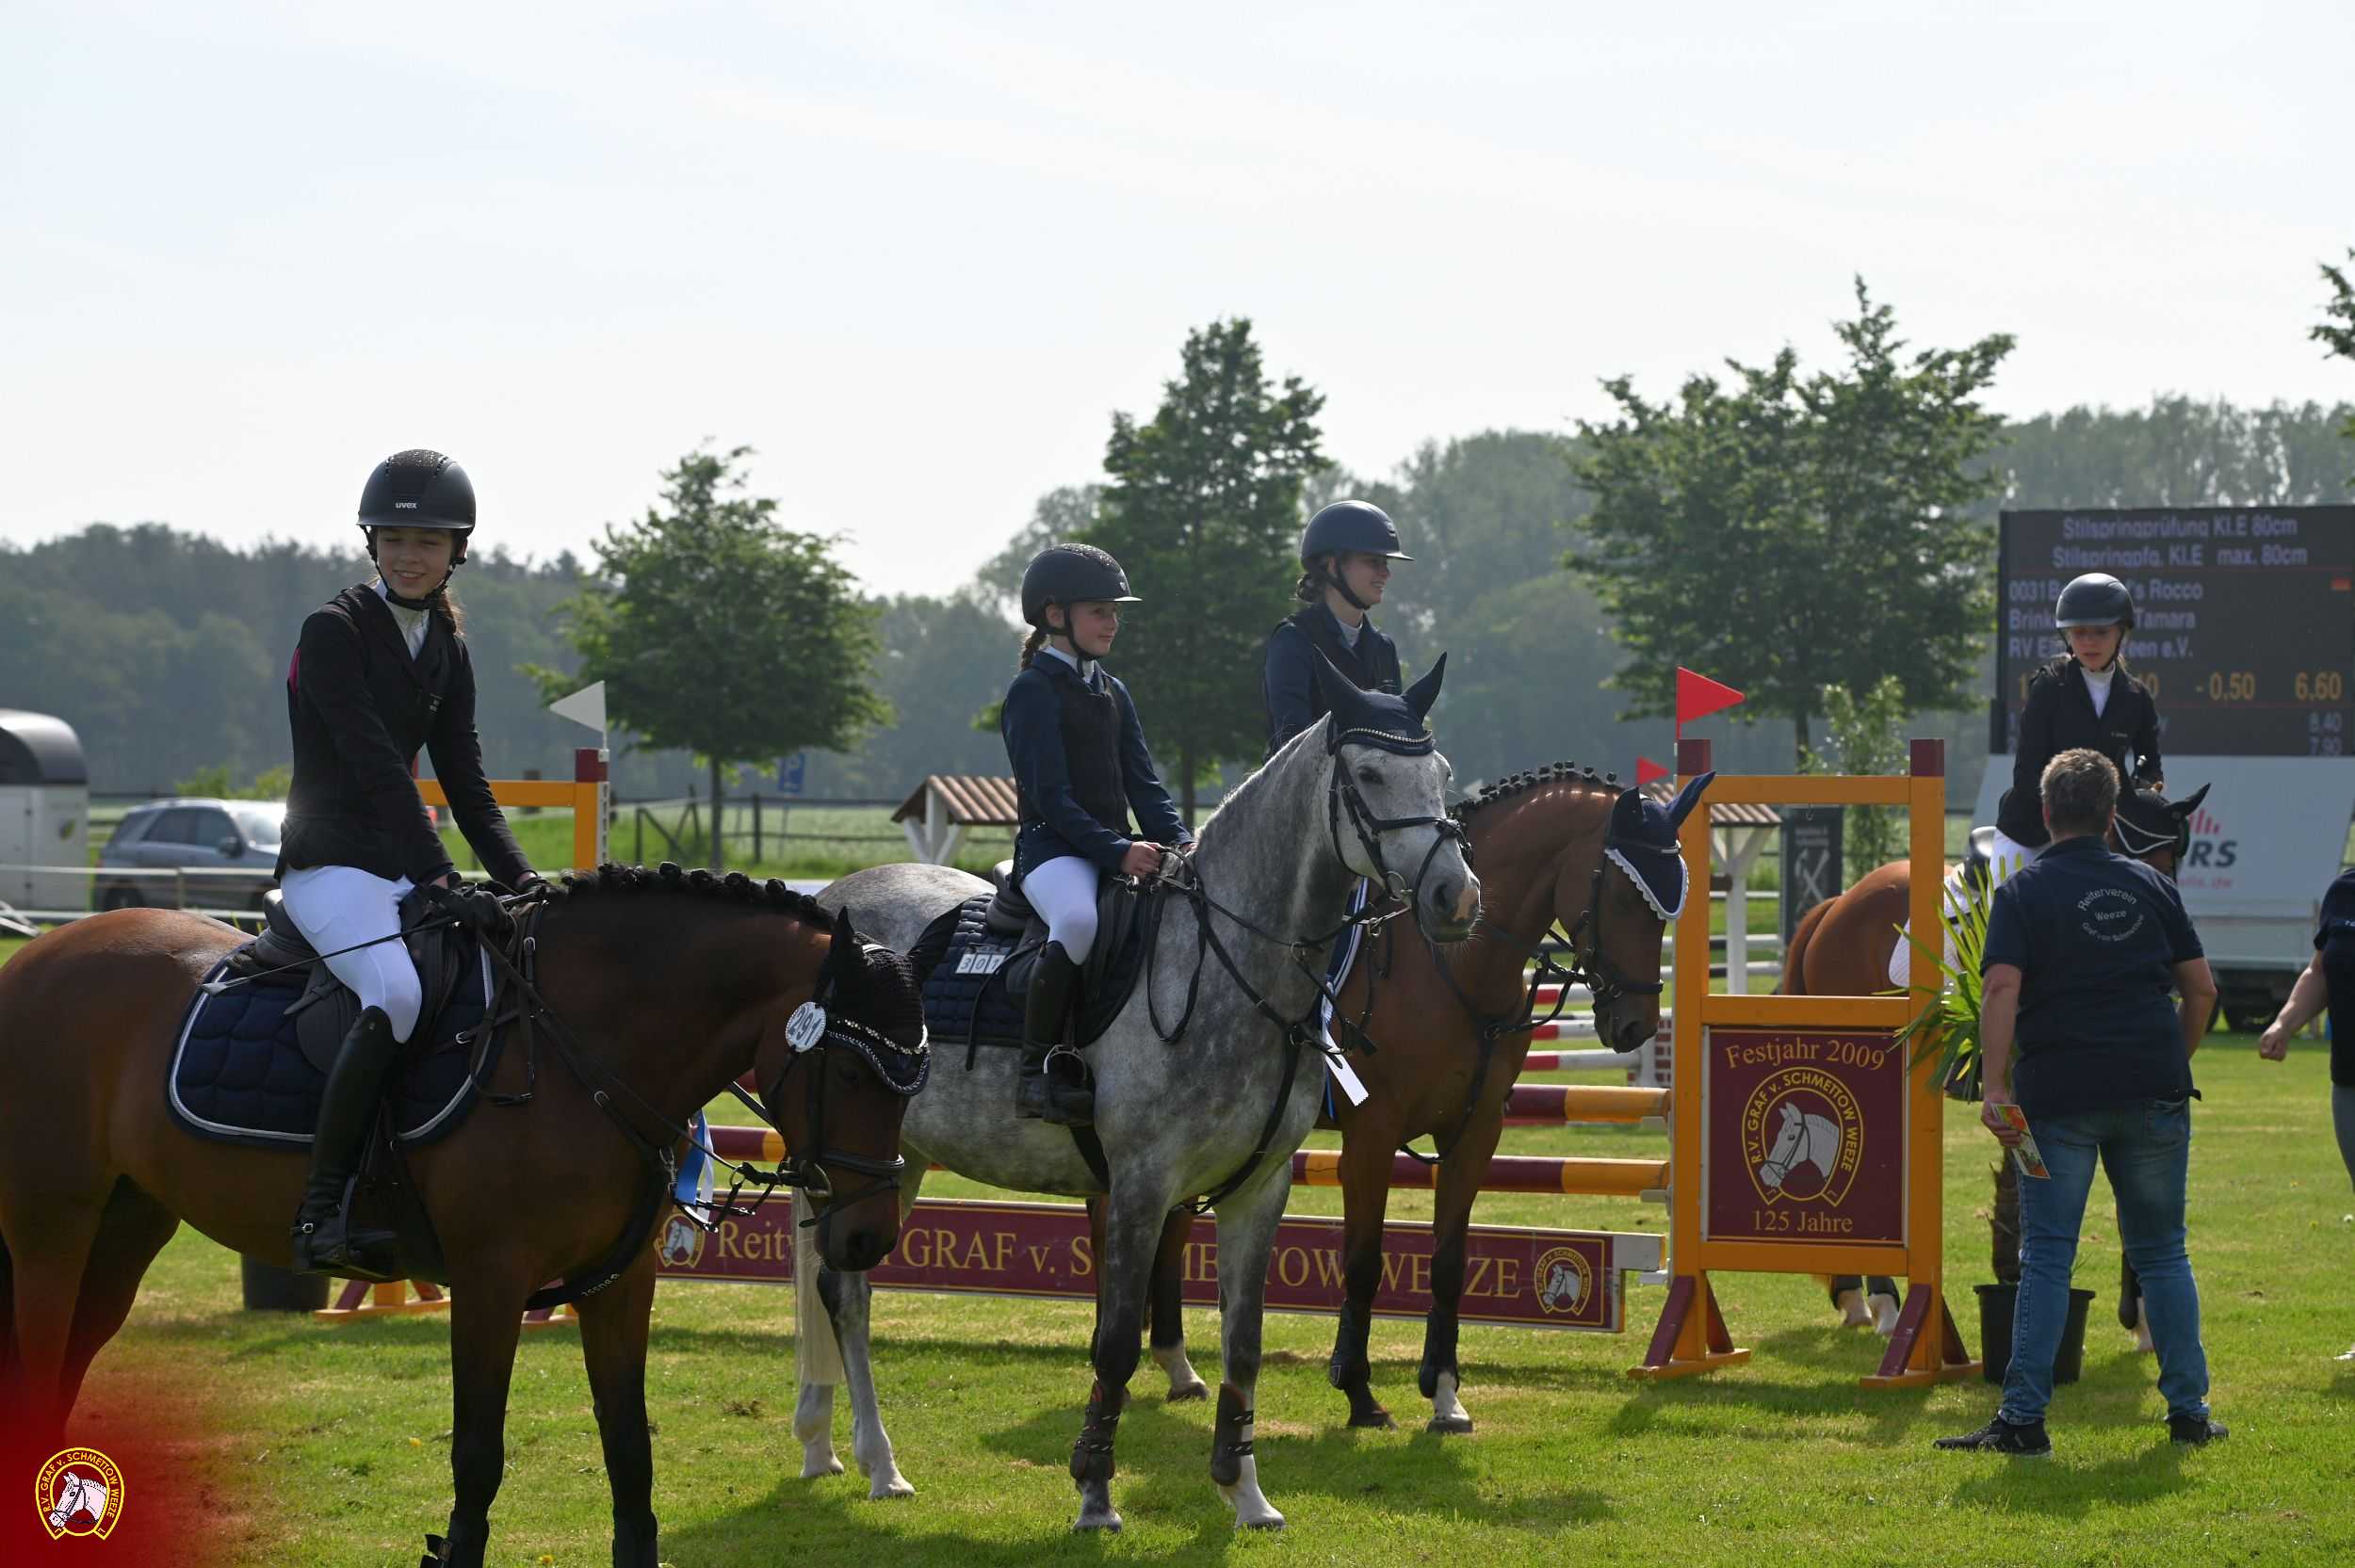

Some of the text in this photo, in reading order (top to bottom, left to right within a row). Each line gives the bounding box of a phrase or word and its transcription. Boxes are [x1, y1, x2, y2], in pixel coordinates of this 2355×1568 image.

[2251, 513, 2298, 536] 80cm
[2217, 546, 2257, 566] max.
[2262, 543, 2308, 566] 80cm
[2150, 578, 2204, 600] Rocco
[2009, 637, 2034, 658] RV
[1726, 1037, 1885, 1071] Festjahr 2009
[1747, 1092, 1769, 1131] GRAF
[1783, 1072, 1856, 1121] SCHMETTOW
[1840, 1126, 1860, 1172] WEEZE
[1753, 1210, 1854, 1233] 125 Jahre
[901, 1227, 1017, 1271] GRAF
[1028, 1245, 1056, 1274] v.
